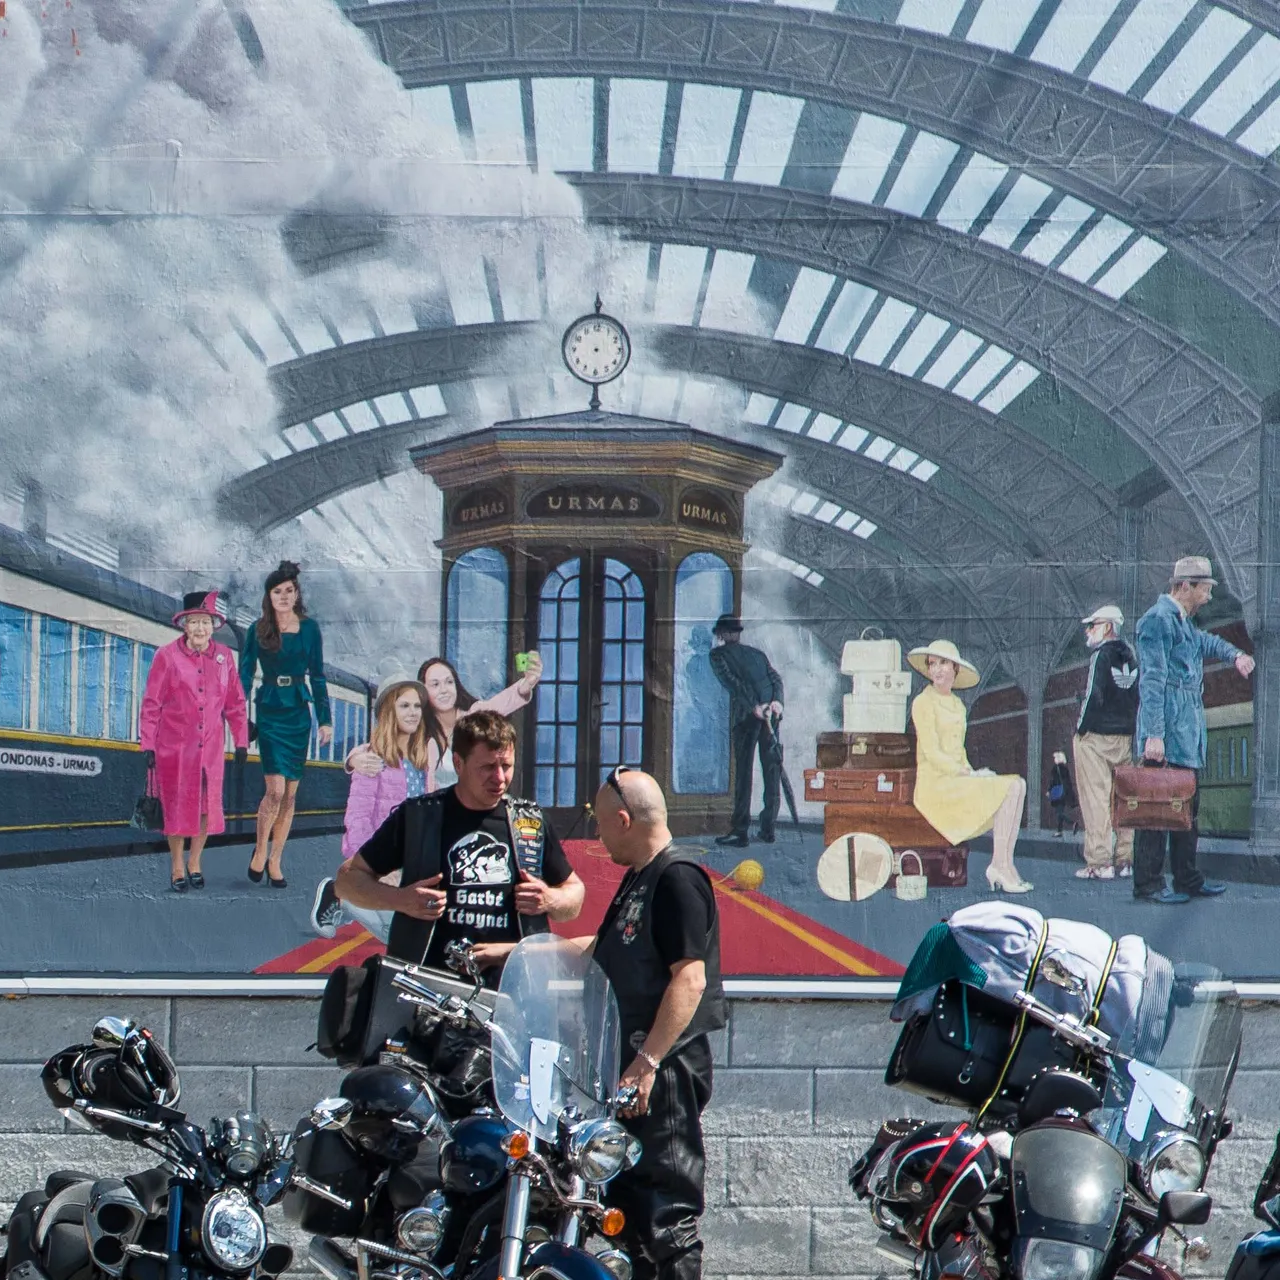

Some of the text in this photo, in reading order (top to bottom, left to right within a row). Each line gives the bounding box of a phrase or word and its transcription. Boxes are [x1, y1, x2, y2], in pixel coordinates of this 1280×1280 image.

[461, 501, 505, 522] URMAS
[548, 496, 640, 511] URMAS
[682, 503, 728, 525] URMAS
[63, 758, 96, 771] URMAS
